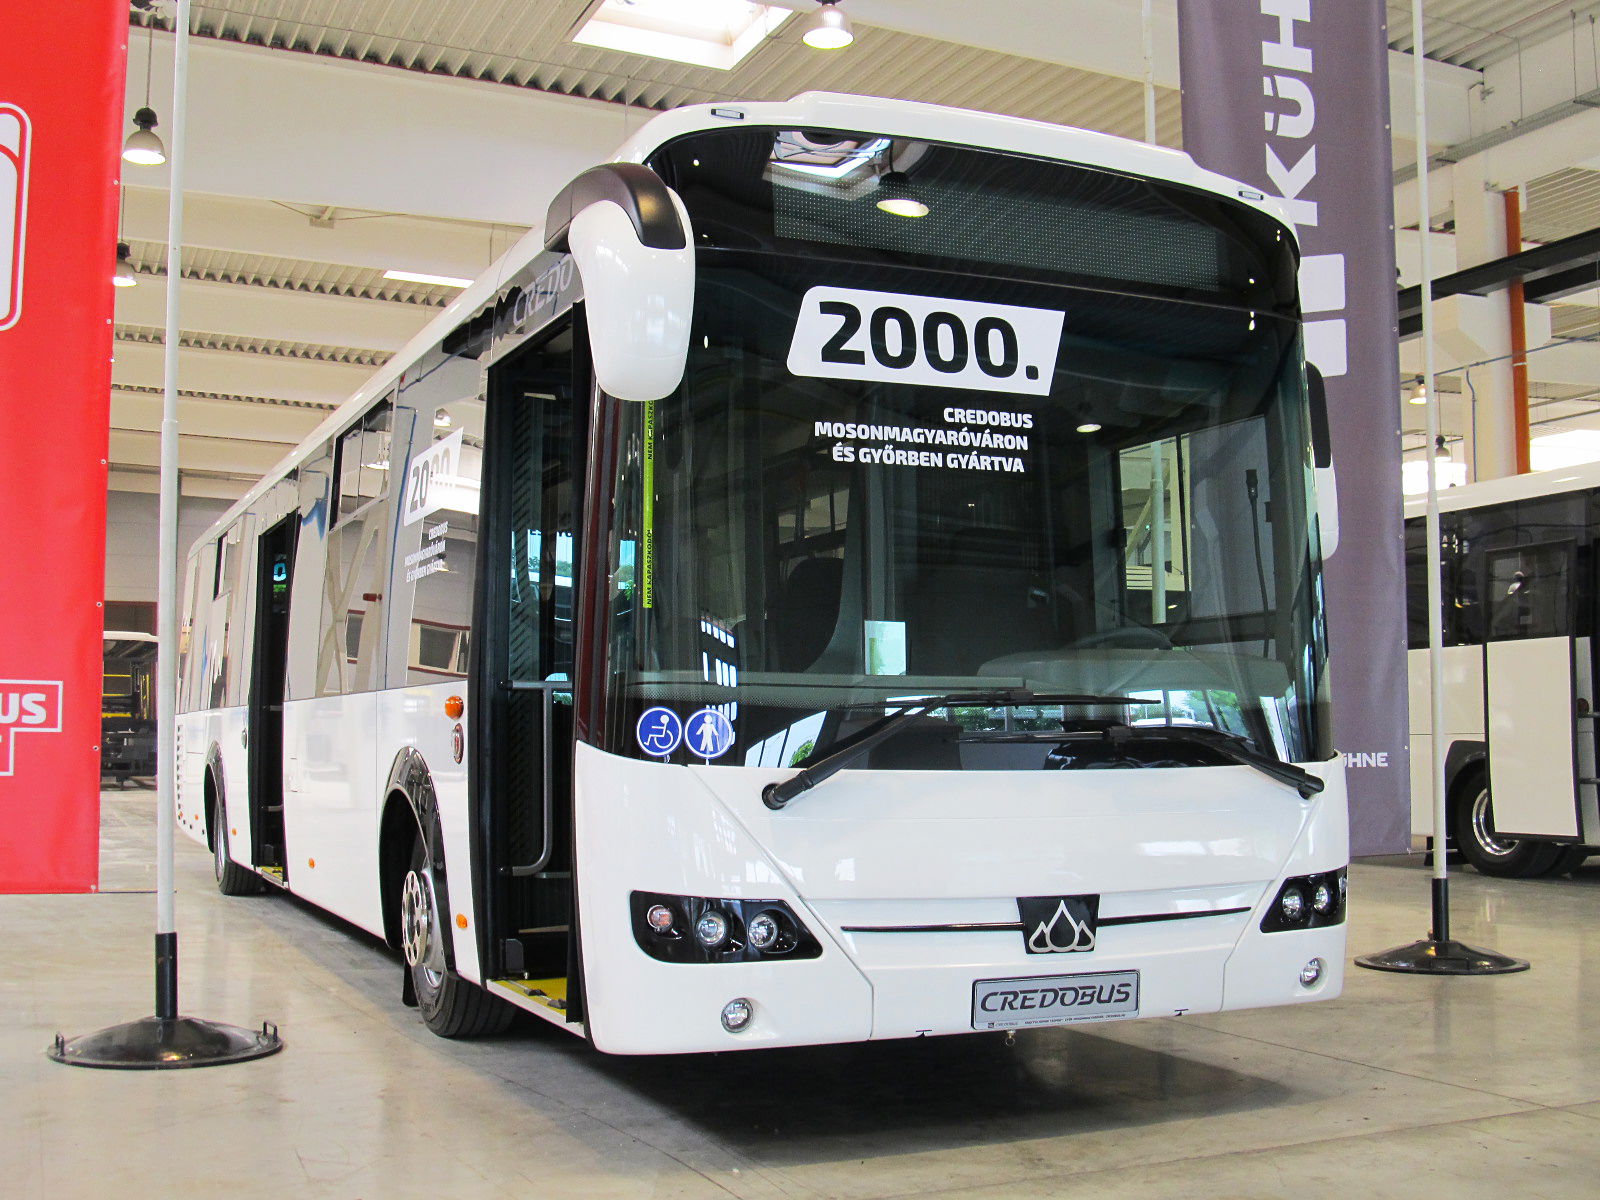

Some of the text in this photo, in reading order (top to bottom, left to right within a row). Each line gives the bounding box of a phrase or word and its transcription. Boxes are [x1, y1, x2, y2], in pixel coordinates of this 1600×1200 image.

[818, 300, 1040, 381] 2000.
[943, 407, 1034, 429] CREDOBUS
[814, 421, 1029, 451] MOSONMAGYARÓVÁRON
[832, 442, 1025, 473] ÉS GYŐRBEN GYÁRTVA
[980, 983, 1132, 1012] CREDOBUS
